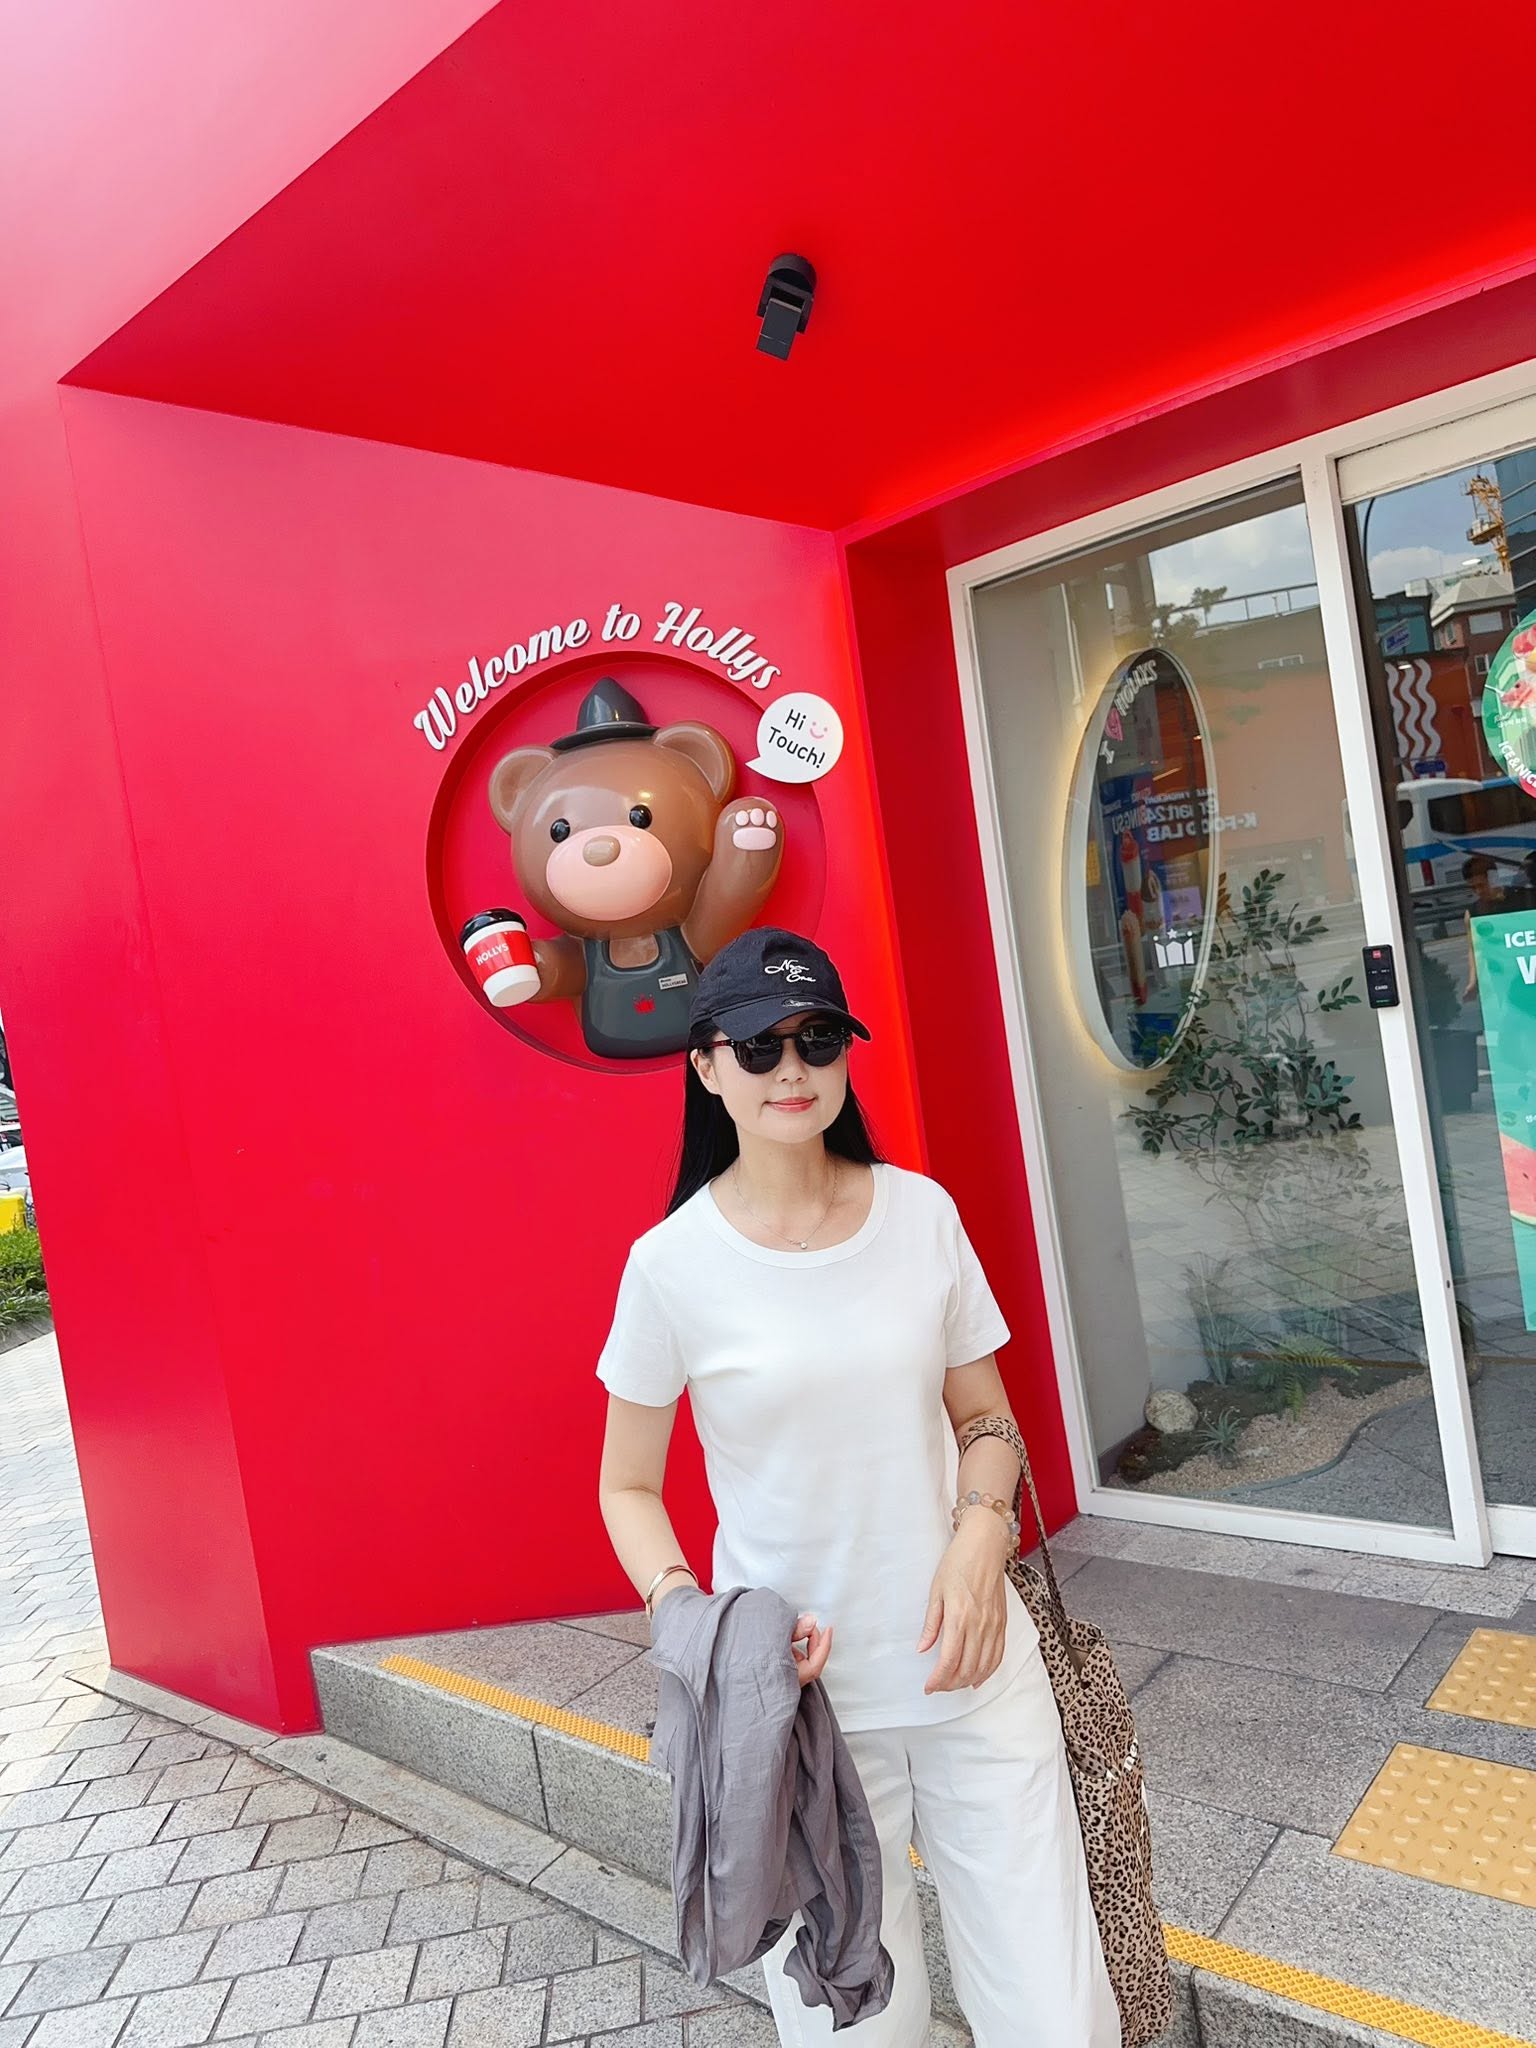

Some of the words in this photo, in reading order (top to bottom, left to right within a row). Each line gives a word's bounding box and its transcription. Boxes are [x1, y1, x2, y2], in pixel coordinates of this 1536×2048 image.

[413, 617, 593, 751] Welcome
[602, 603, 641, 641] to
[654, 601, 782, 690] Hollys
[786, 708, 807, 731] Hi
[768, 727, 826, 769] Touch!
[475, 943, 509, 966] HOLLYS
